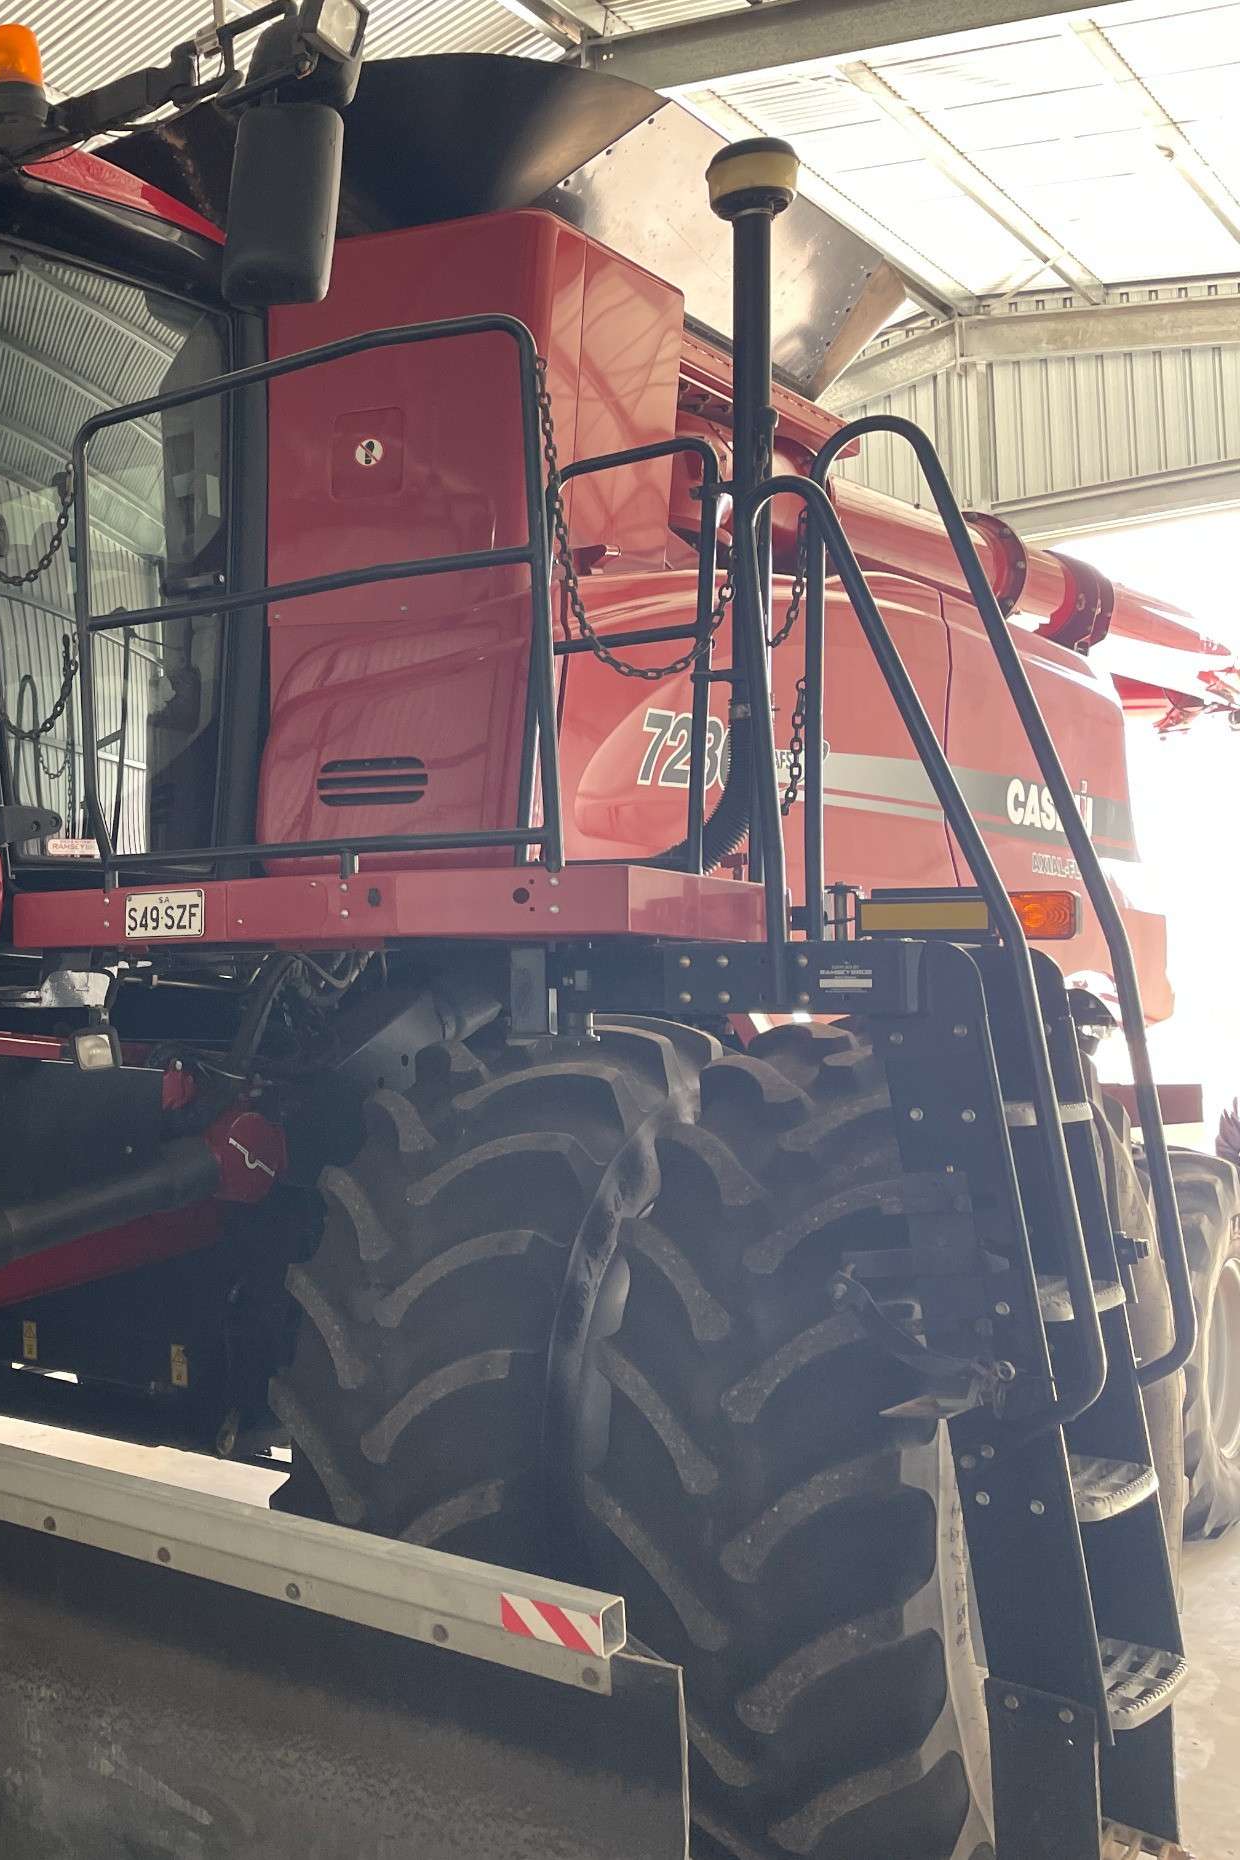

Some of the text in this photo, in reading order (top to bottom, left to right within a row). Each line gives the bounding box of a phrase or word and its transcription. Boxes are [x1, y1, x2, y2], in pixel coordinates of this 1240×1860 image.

[1006, 778, 1065, 832] CAS
[1031, 852, 1083, 880] AXIAL-FL
[158, 896, 170, 904] SA
